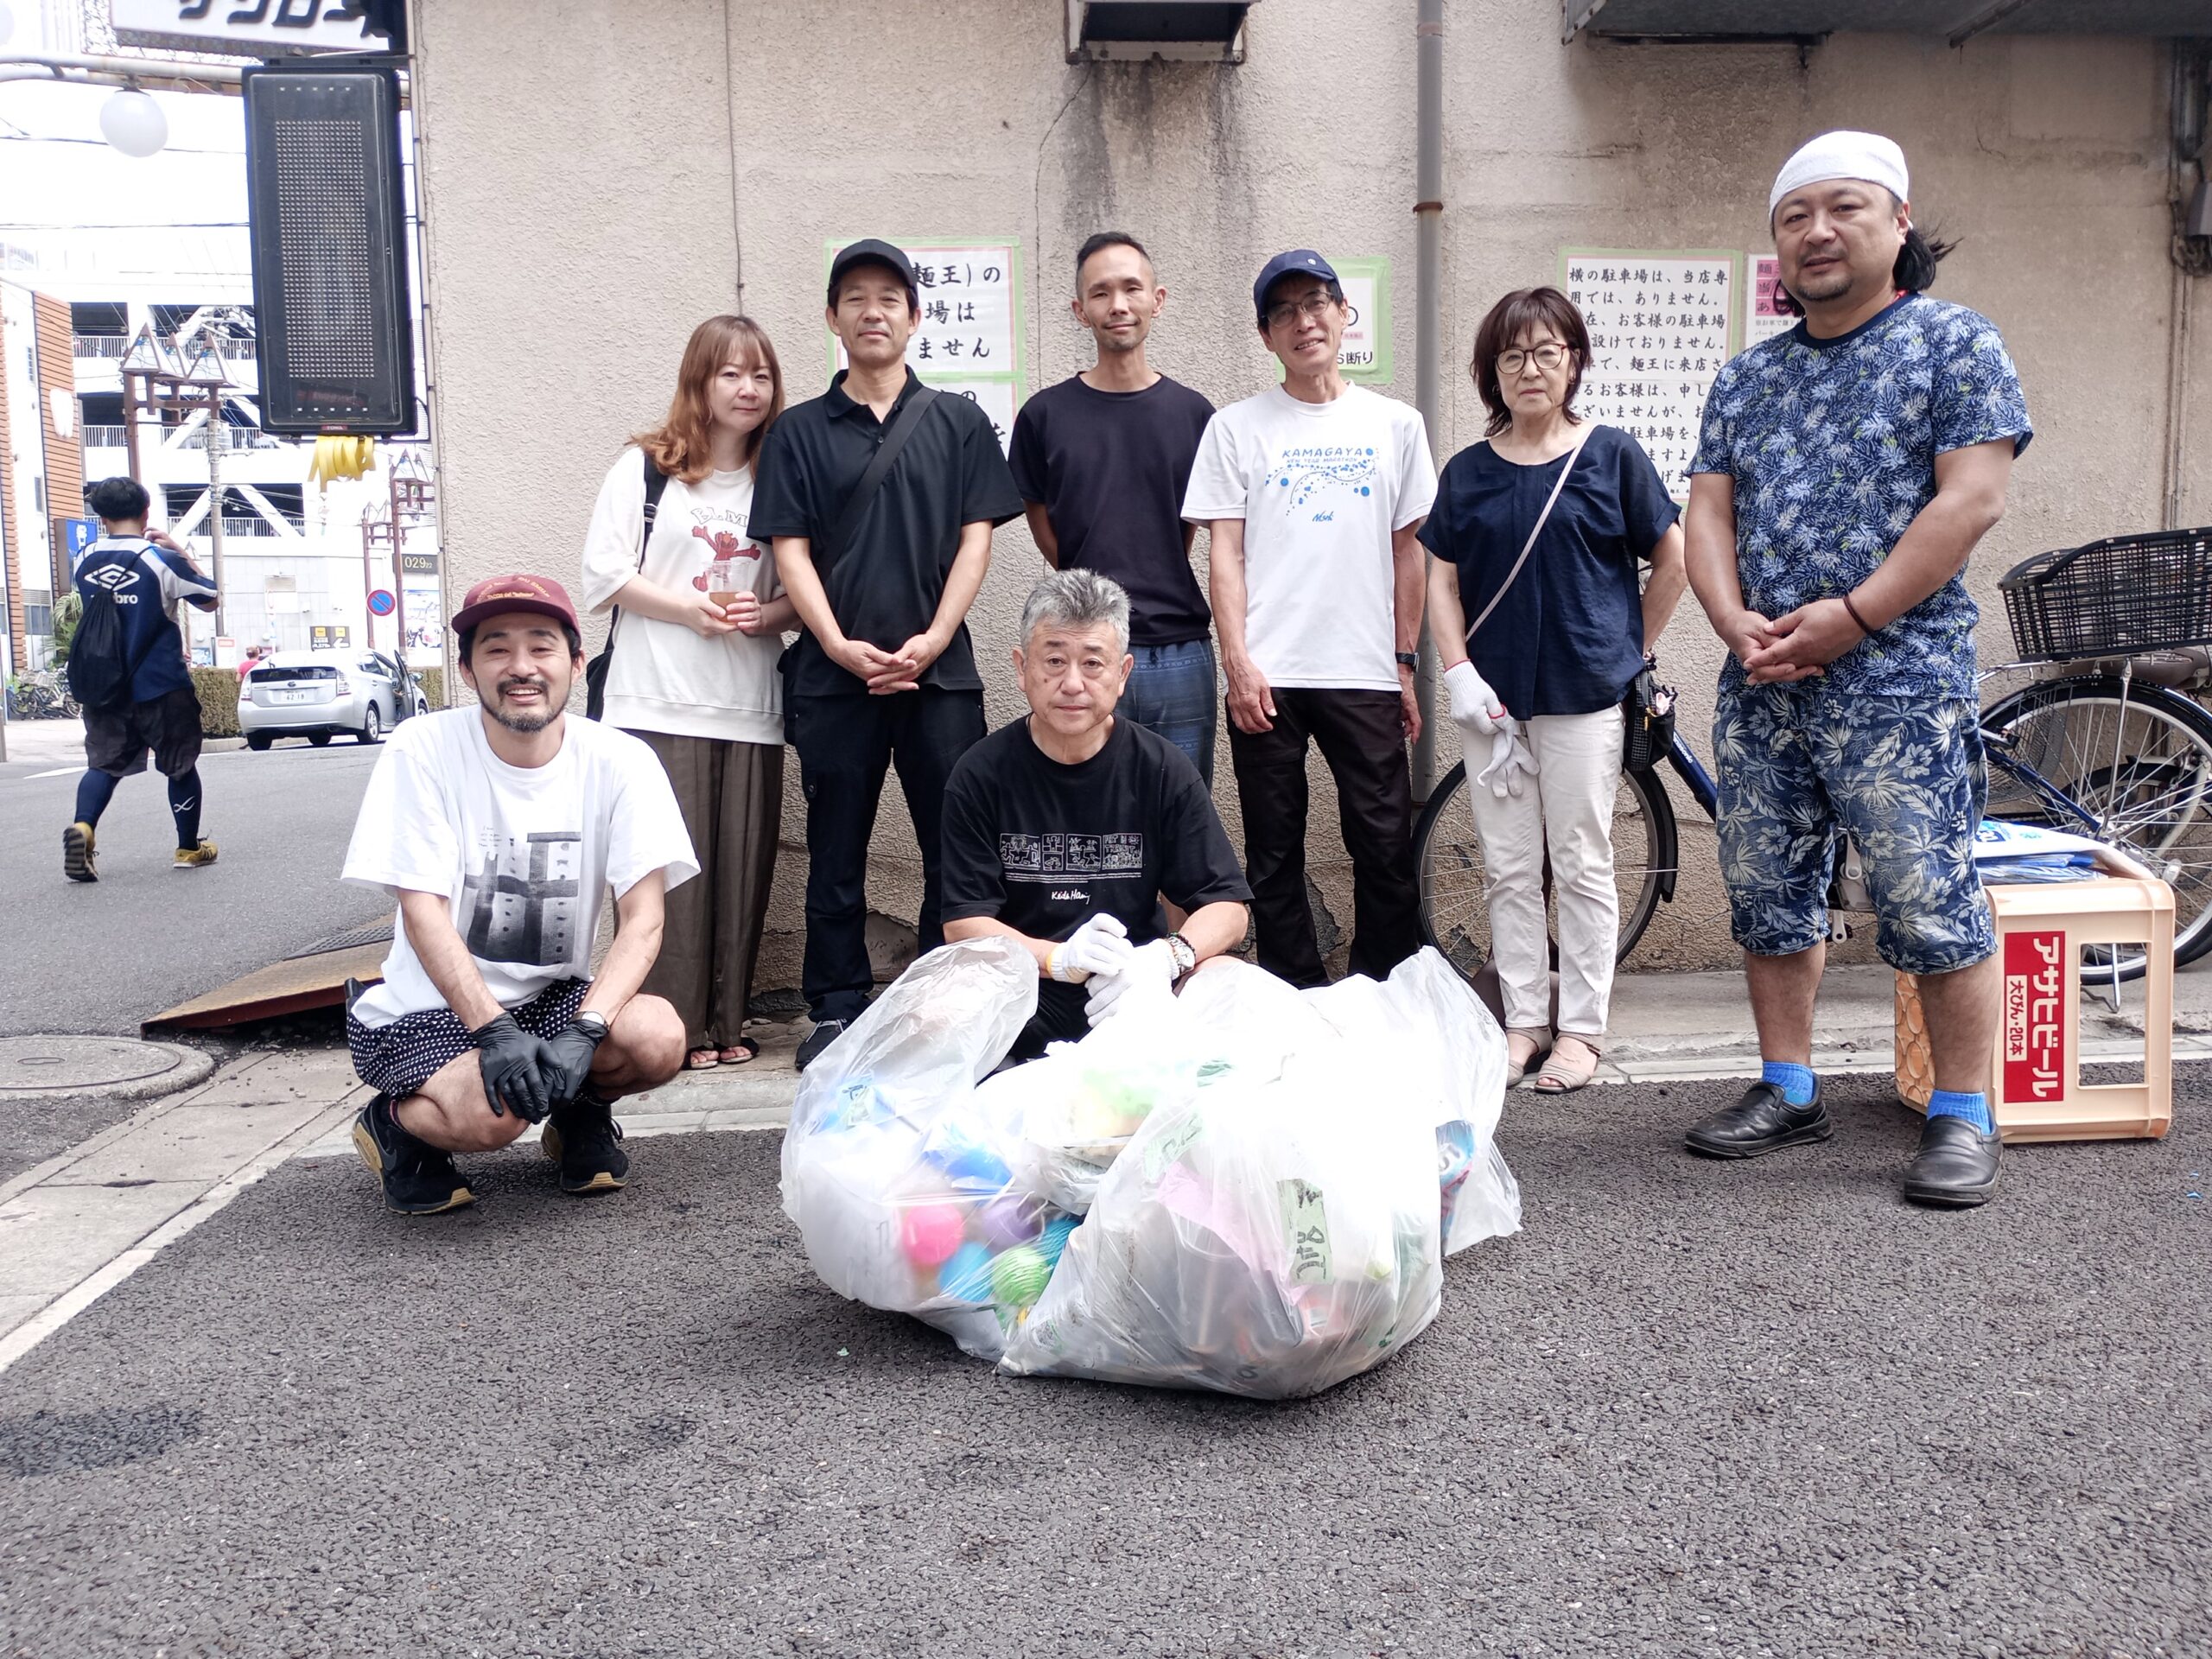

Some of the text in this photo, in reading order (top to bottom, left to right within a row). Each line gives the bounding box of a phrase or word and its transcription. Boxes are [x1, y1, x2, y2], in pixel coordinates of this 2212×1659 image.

[1568, 267, 1728, 286] 横の駐車場は、当店専
[1570, 290, 1719, 307] 用では、ありません。
[925, 300, 976, 325] 場は
[1584, 311, 1726, 329] 在、お客様の駐車場
[918, 336, 990, 359] ません
[1591, 334, 1725, 350] 設けておりません。
[1576, 382, 1706, 398] るお客様は、申し
[1282, 447, 1363, 459] KAMAGAYA
[404, 556, 427, 568] 029
[2009, 980, 2024, 1056] 大びん・20本
[2032, 937, 2060, 1097] アサヒビール
